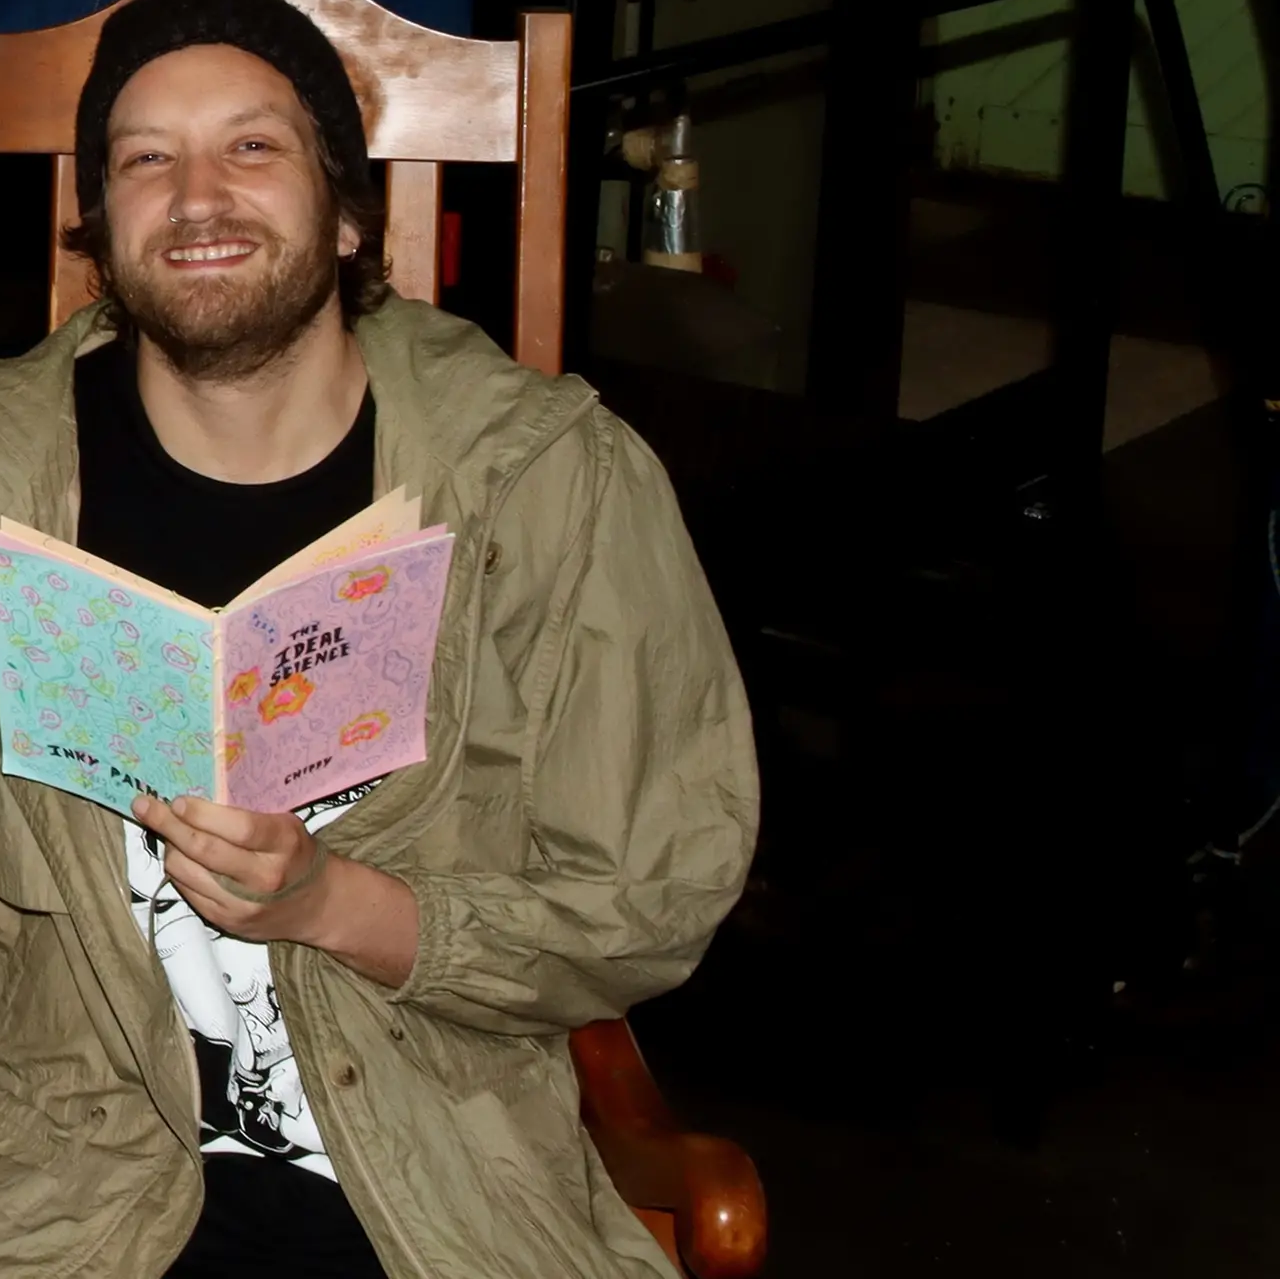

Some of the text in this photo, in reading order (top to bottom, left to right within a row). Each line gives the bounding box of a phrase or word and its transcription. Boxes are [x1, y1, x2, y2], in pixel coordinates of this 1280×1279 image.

[289, 621, 320, 640] THE
[274, 627, 345, 669] IDEAL
[269, 642, 349, 687] SCIENCE
[47, 744, 100, 766] INKY
[284, 756, 332, 785] CHIPPY
